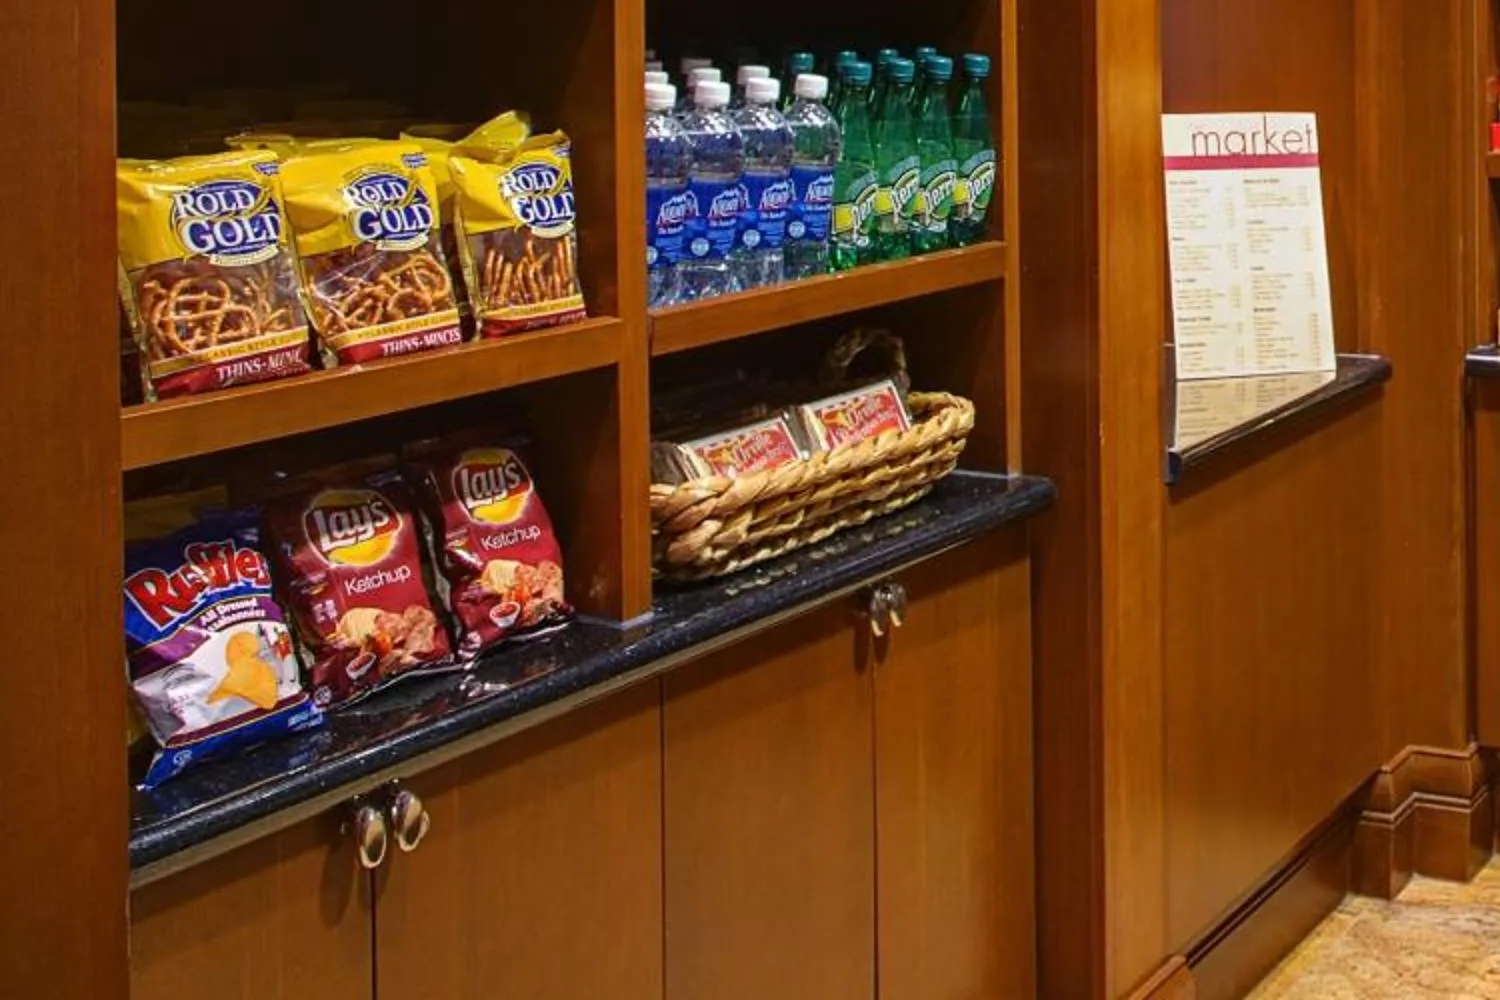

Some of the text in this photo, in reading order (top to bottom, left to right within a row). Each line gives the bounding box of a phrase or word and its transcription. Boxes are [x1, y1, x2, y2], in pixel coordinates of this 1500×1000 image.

[1191, 114, 1313, 157] market
[499, 170, 558, 199] ROLD
[174, 188, 257, 219] ROLD
[353, 203, 433, 240] GOLD
[480, 524, 542, 551] Ketchup
[344, 564, 411, 595] Ketchup
